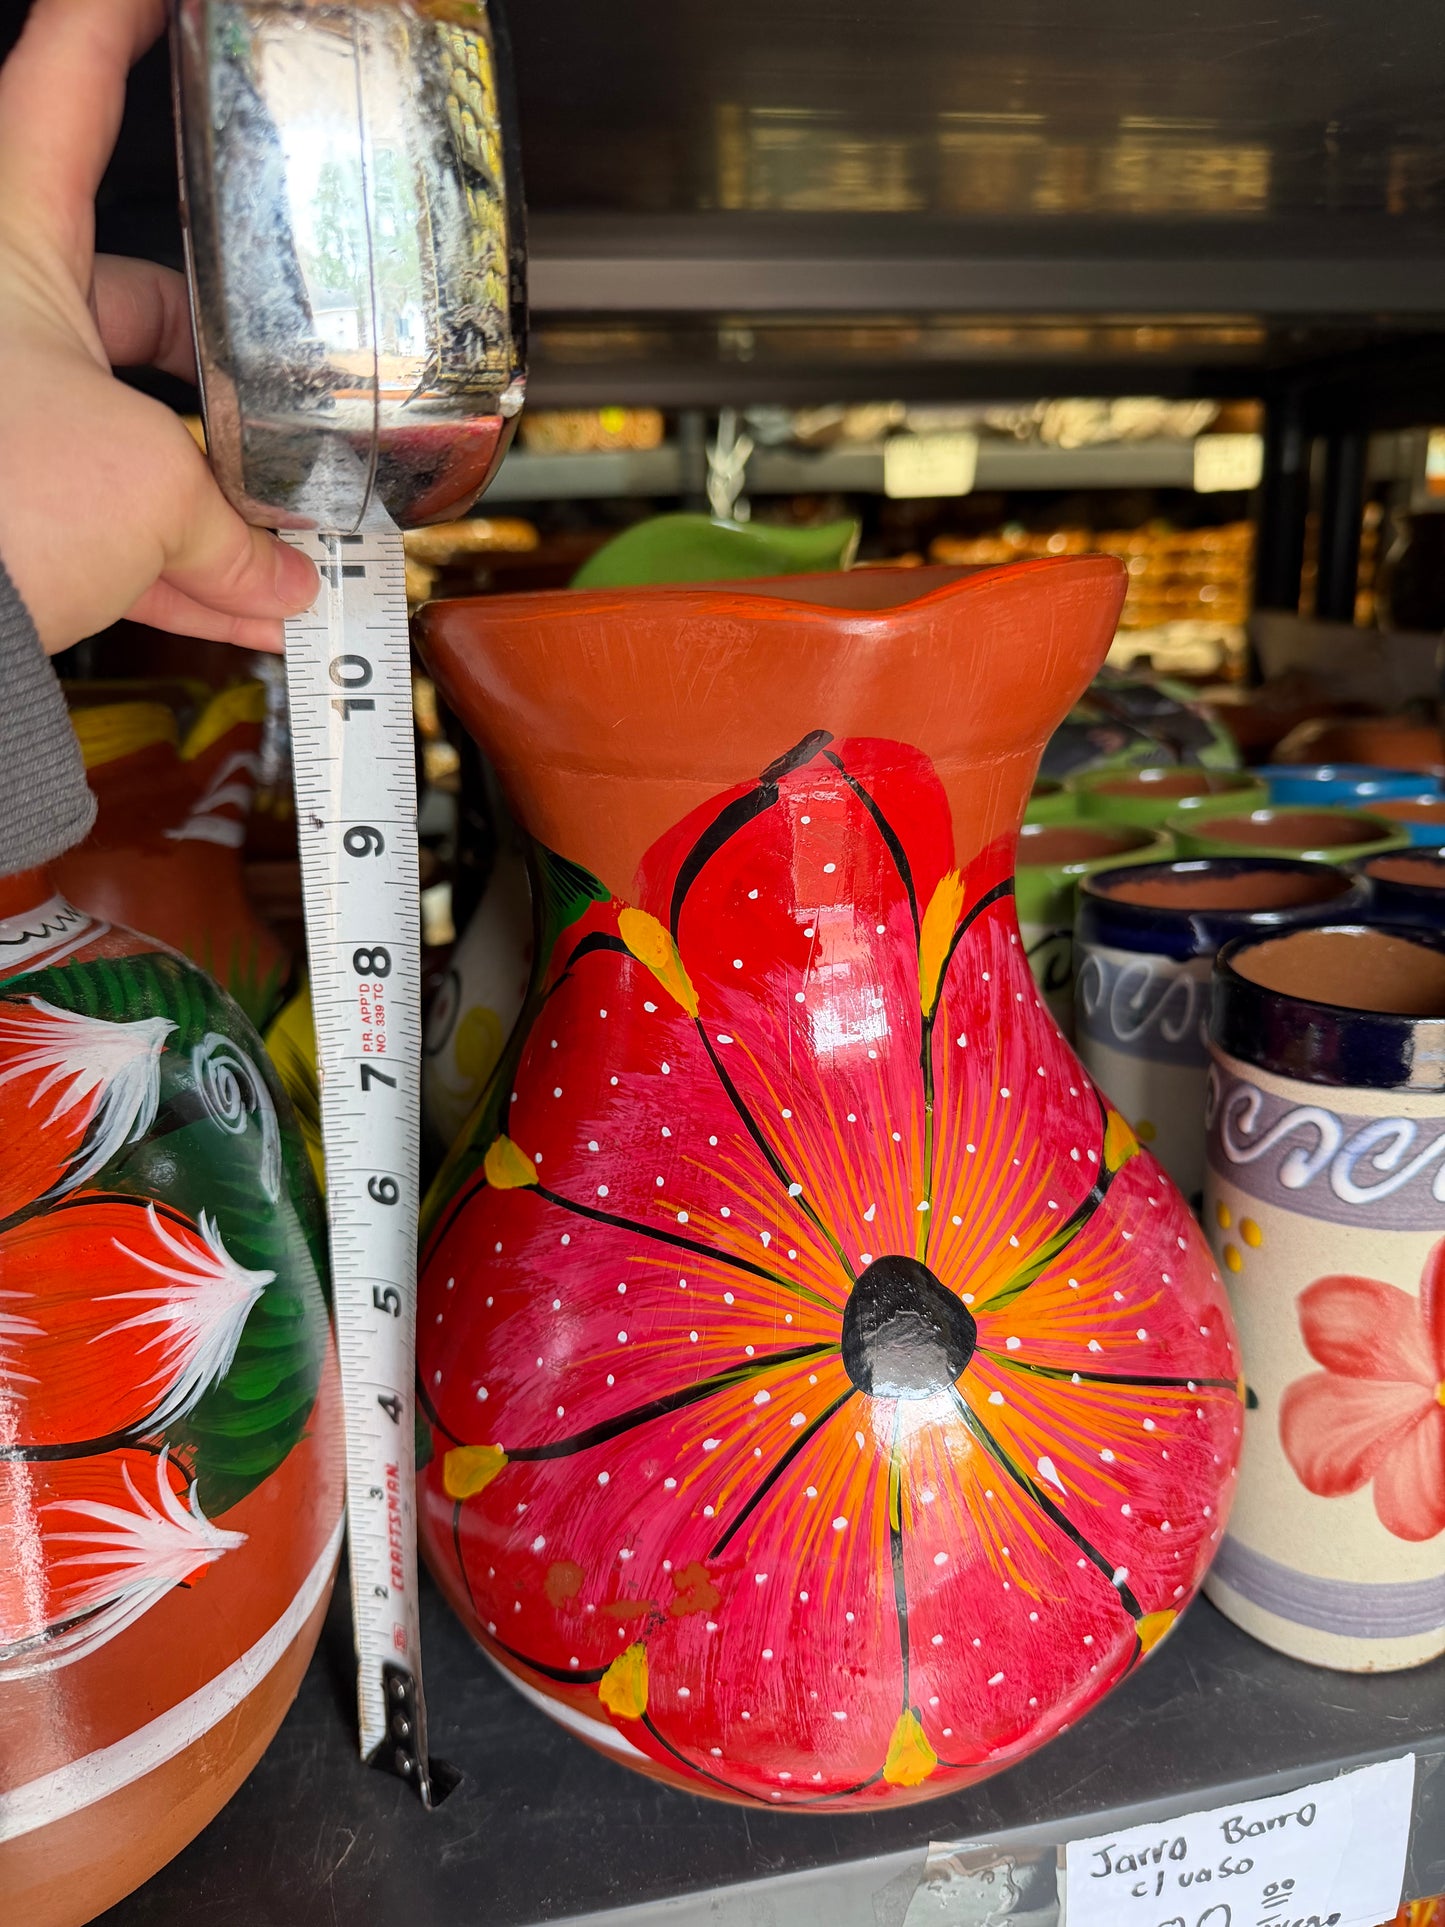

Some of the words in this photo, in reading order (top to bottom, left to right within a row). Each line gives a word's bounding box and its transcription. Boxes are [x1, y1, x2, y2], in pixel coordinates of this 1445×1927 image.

[318, 533, 367, 589] 11
[328, 653, 376, 722] 10
[342, 825, 386, 859] 9
[352, 946, 392, 979] 8
[359, 983, 373, 1024] APP'D
[373, 983, 384, 1001] TC
[375, 1005, 386, 1027] 339
[361, 1028, 374, 1053] P.R.
[375, 1031, 387, 1053] NO.
[360, 1063, 397, 1092] 7
[367, 1174, 401, 1207] 6
[372, 1284, 402, 1318] 5
[377, 1393, 404, 1425] 4
[369, 1486, 384, 1500] 3
[384, 1462, 405, 1593] CRAFTSMAN
[374, 1586, 389, 1599] 2
[1090, 1836, 1188, 1879] Jarro
[1220, 1802, 1317, 1845] Barro
